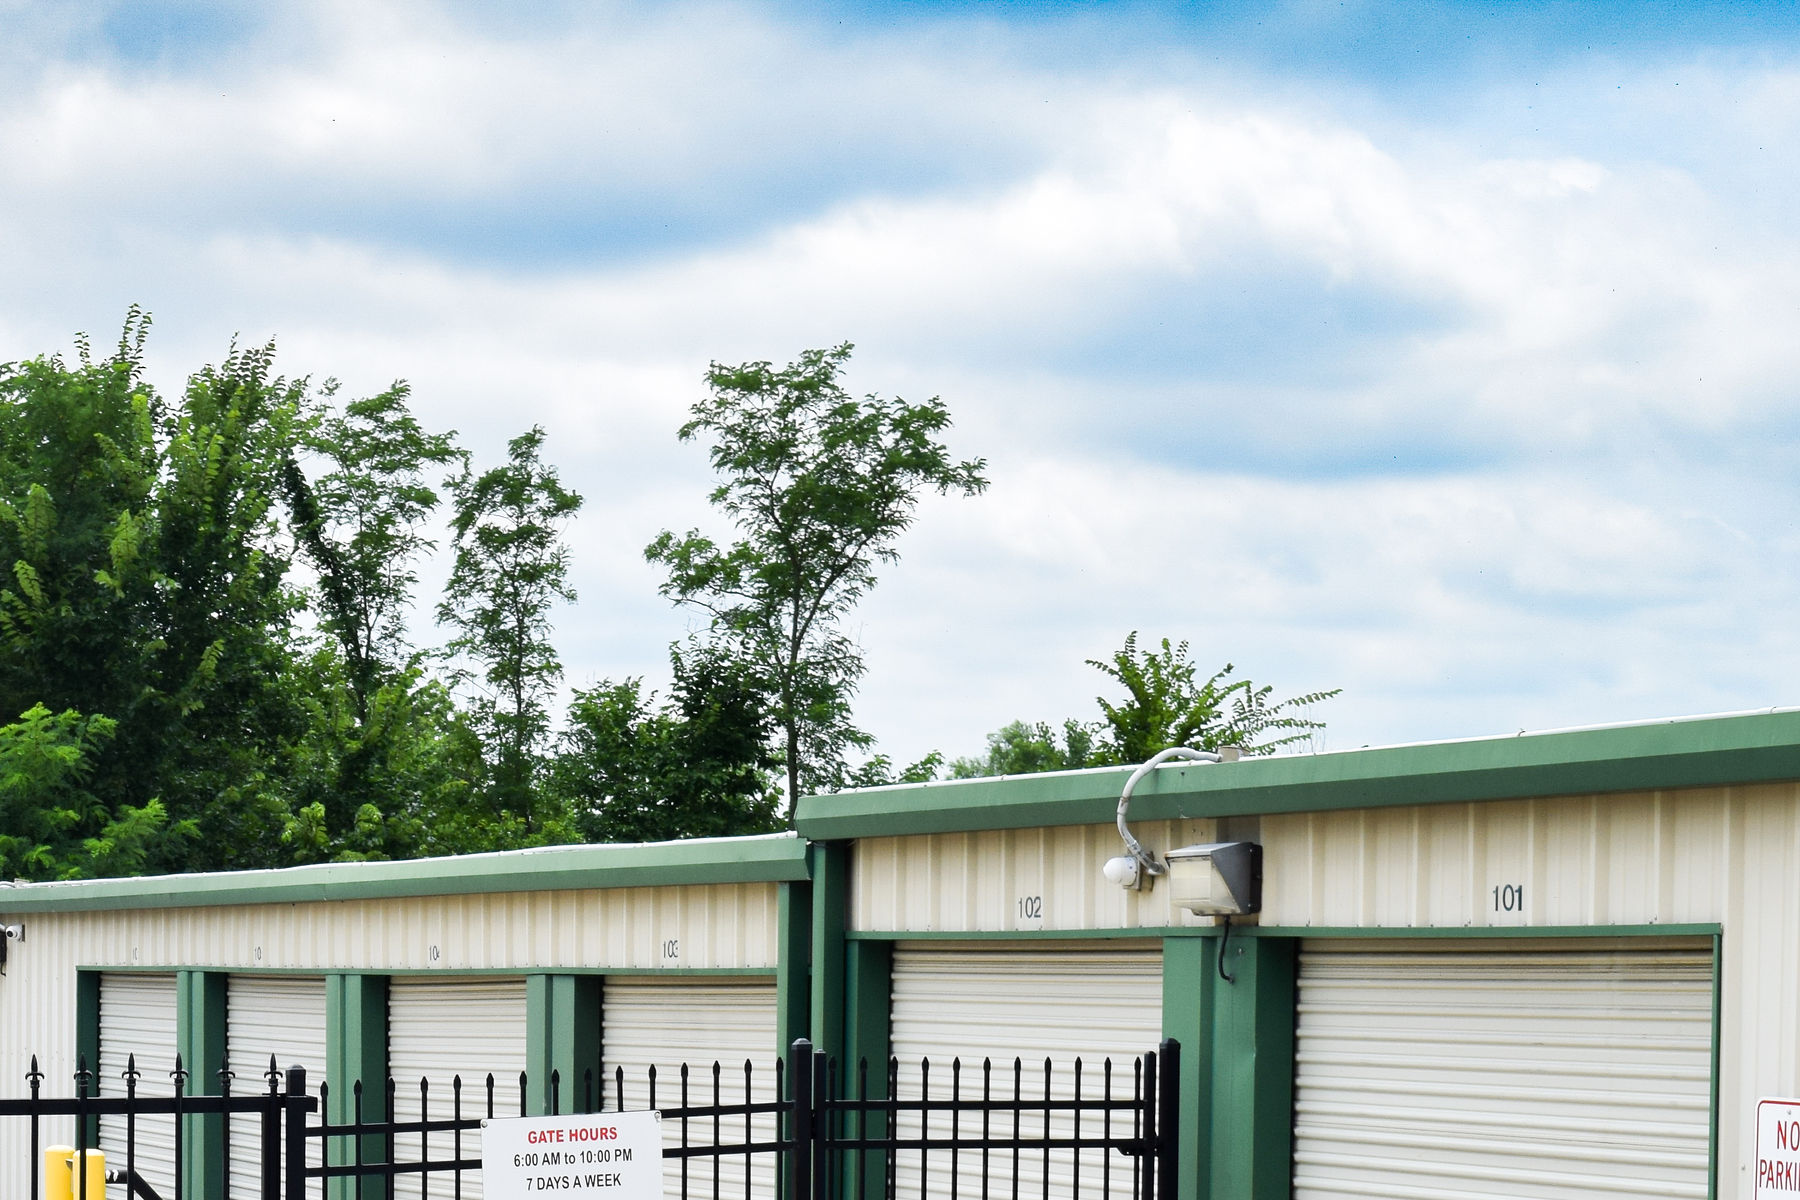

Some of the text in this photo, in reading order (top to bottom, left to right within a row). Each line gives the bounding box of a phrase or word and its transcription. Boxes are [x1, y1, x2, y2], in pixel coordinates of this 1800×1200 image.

[1018, 896, 1041, 918] 102
[1493, 884, 1522, 911] 101
[528, 1127, 618, 1144] GATE HOURS
[1777, 1120, 1800, 1151] NO
[514, 1148, 633, 1167] 6:00 AM to 10:00 PM
[526, 1173, 622, 1190] 7 DAYS A WEEK
